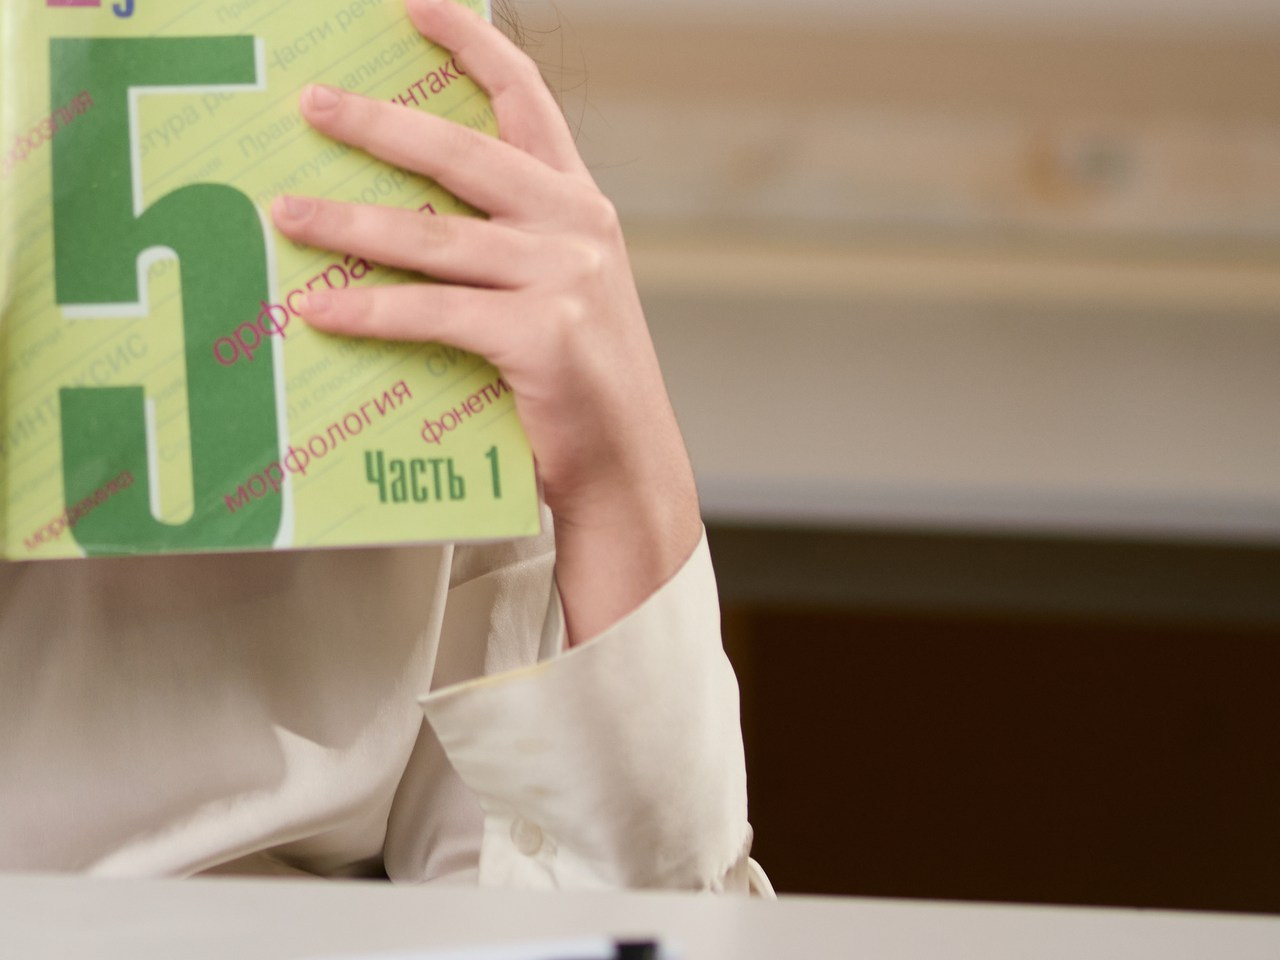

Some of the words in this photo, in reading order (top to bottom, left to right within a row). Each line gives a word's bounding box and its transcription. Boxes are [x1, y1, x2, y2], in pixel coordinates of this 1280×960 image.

[49, 35, 293, 557] 5
[224, 378, 415, 514] морфология
[420, 376, 515, 446] фонети
[363, 447, 467, 505] Часть
[484, 444, 504, 501] 1
